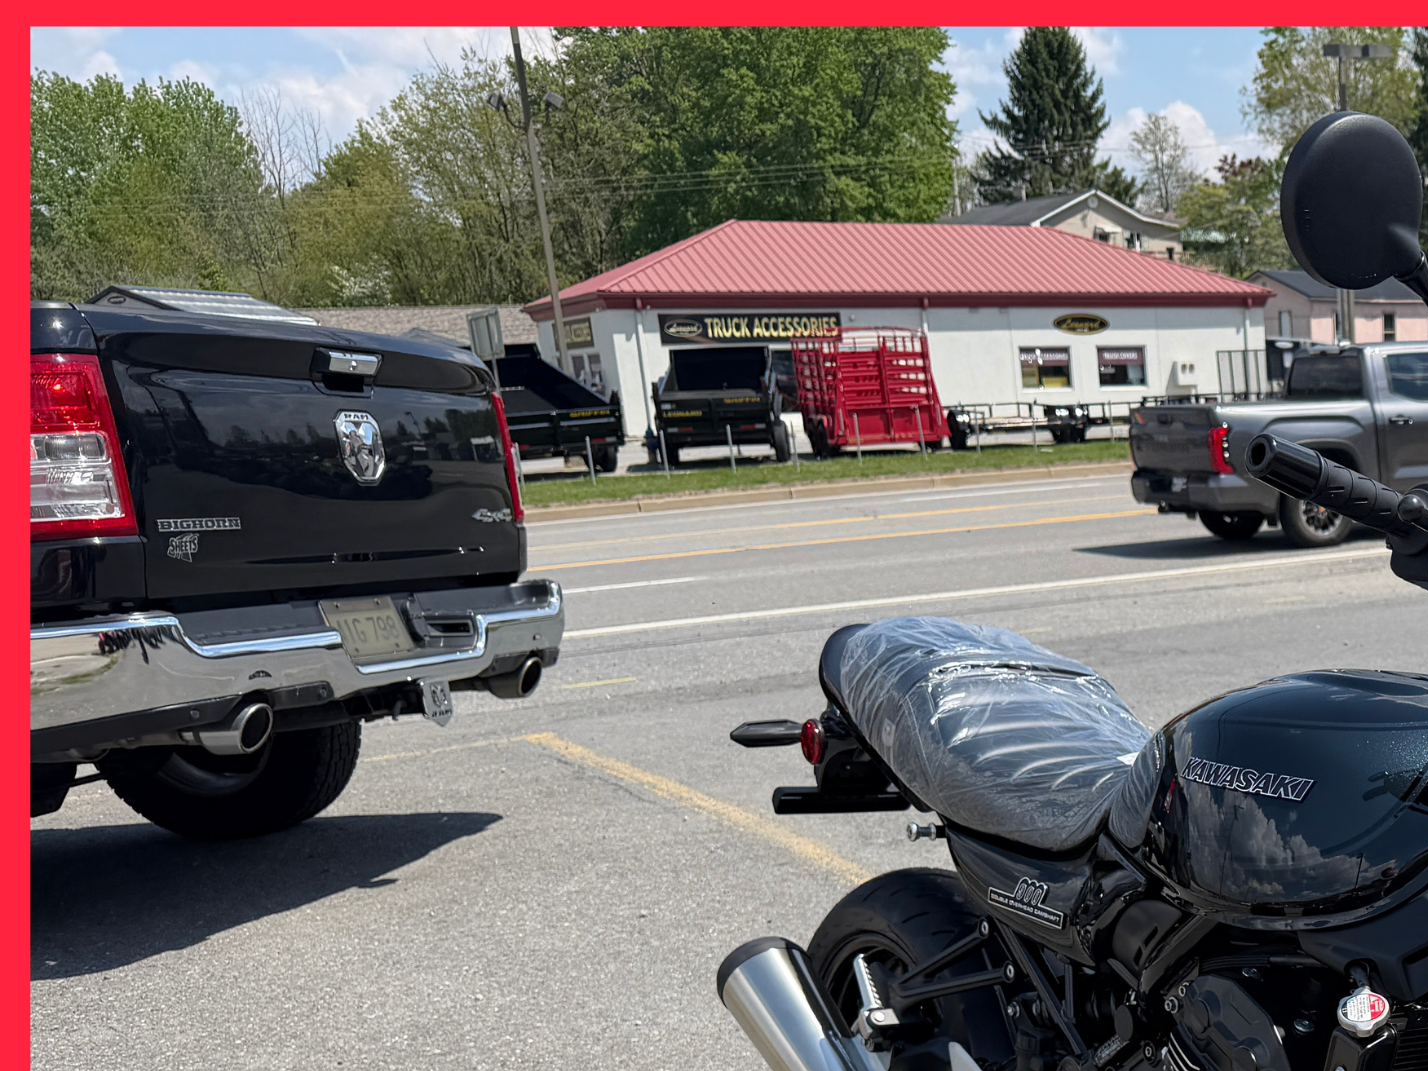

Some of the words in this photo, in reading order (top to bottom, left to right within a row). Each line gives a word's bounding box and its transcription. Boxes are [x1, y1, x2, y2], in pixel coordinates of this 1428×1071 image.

[704, 316, 750, 338] TRUCK
[753, 316, 839, 338] ACCESSORIES
[157, 517, 242, 532] BIGHORN
[1180, 756, 1315, 801] KAWASAKI
